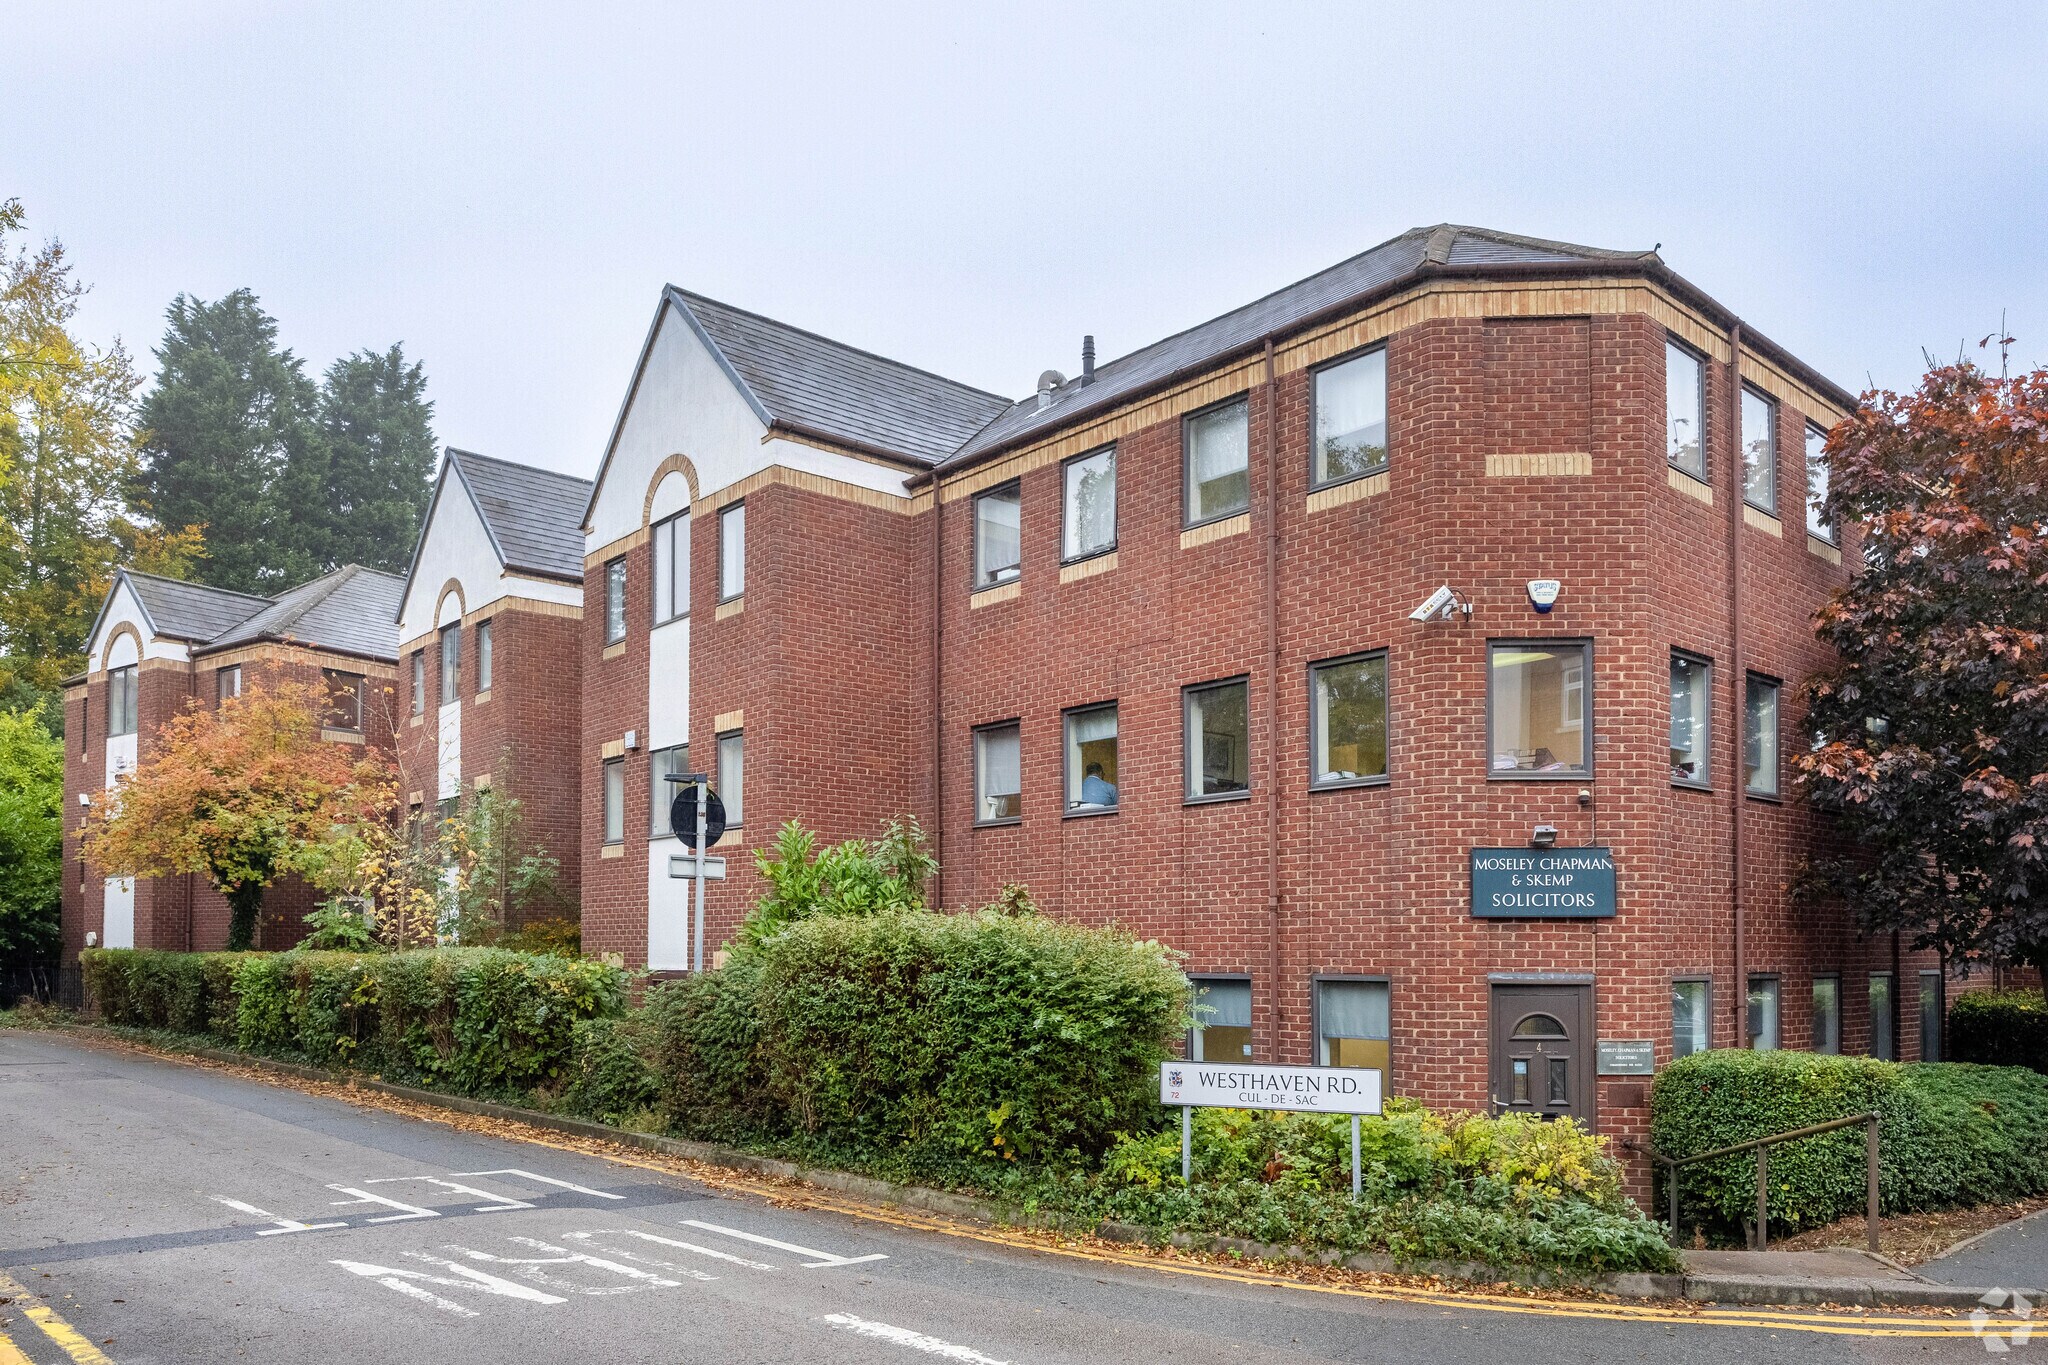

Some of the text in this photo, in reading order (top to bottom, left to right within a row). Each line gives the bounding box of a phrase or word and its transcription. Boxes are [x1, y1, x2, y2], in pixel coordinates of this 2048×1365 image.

[1475, 858, 1612, 870] MOSELEY CHAPMAN
[1511, 874, 1573, 886] & SKEMP
[1492, 893, 1595, 907] SOLICITORS
[1536, 1042, 1542, 1053] 4
[1199, 1071, 1362, 1095] WESTHAVEN RD.
[1170, 1091, 1180, 1099] 72
